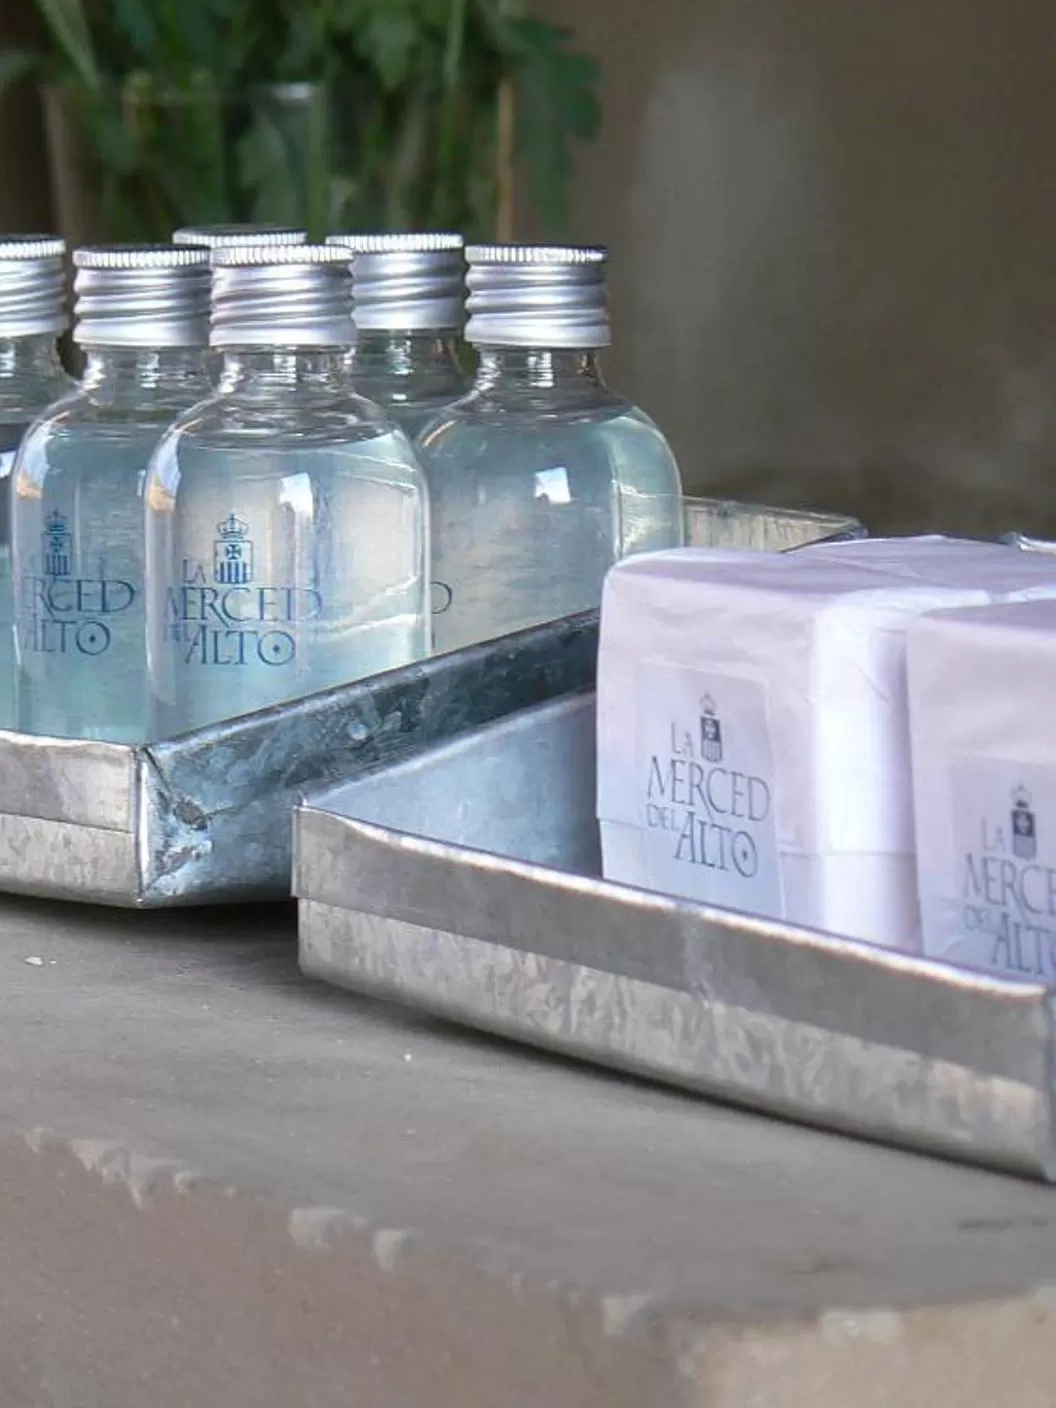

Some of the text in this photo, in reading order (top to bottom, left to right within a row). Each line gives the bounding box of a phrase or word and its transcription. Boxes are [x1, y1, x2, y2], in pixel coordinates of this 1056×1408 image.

[182, 558, 206, 584] LA
[164, 586, 323, 628] MERCED
[184, 624, 296, 666] ALTO
[670, 720, 694, 758] LA
[646, 755, 772, 822] MERCED
[672, 810, 759, 878] ALTO
[962, 852, 1056, 920] MERCE
[990, 911, 1056, 974] ALT
